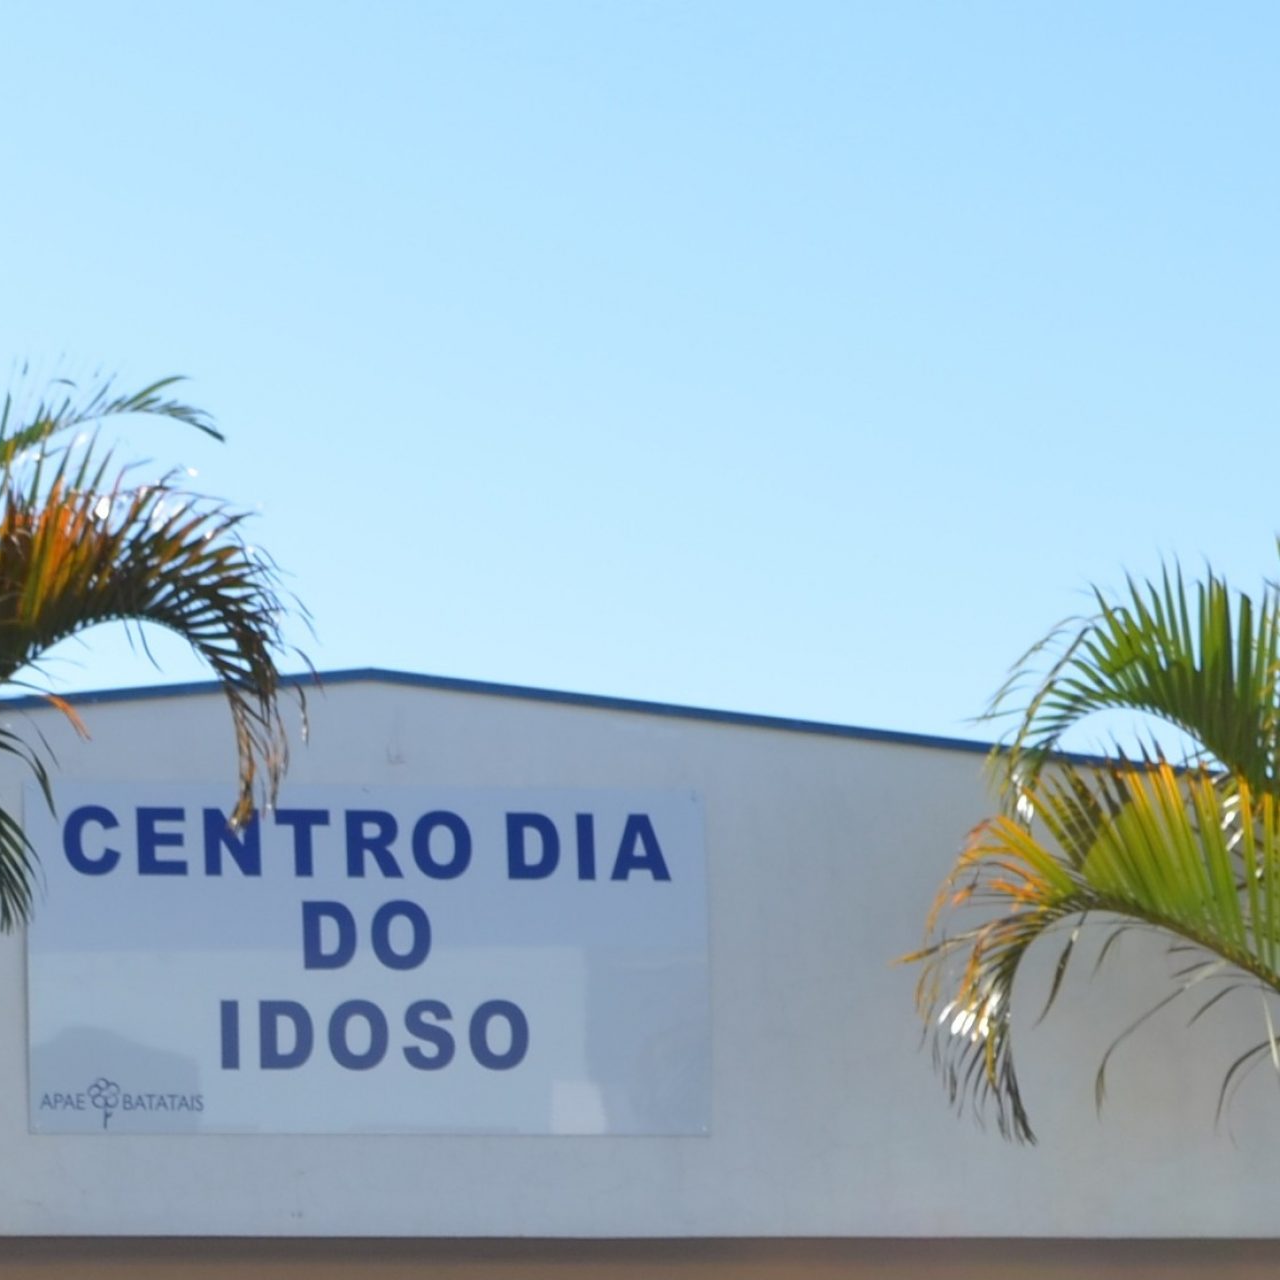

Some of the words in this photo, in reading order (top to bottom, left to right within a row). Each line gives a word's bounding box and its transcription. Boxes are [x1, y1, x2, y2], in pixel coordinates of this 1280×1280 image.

[62, 804, 473, 880] CENTRO
[505, 812, 672, 882] DIA
[301, 899, 433, 971] DO
[220, 999, 529, 1071] IDOSO
[40, 1092, 86, 1111] APAE
[122, 1094, 205, 1112] BATATAIS
